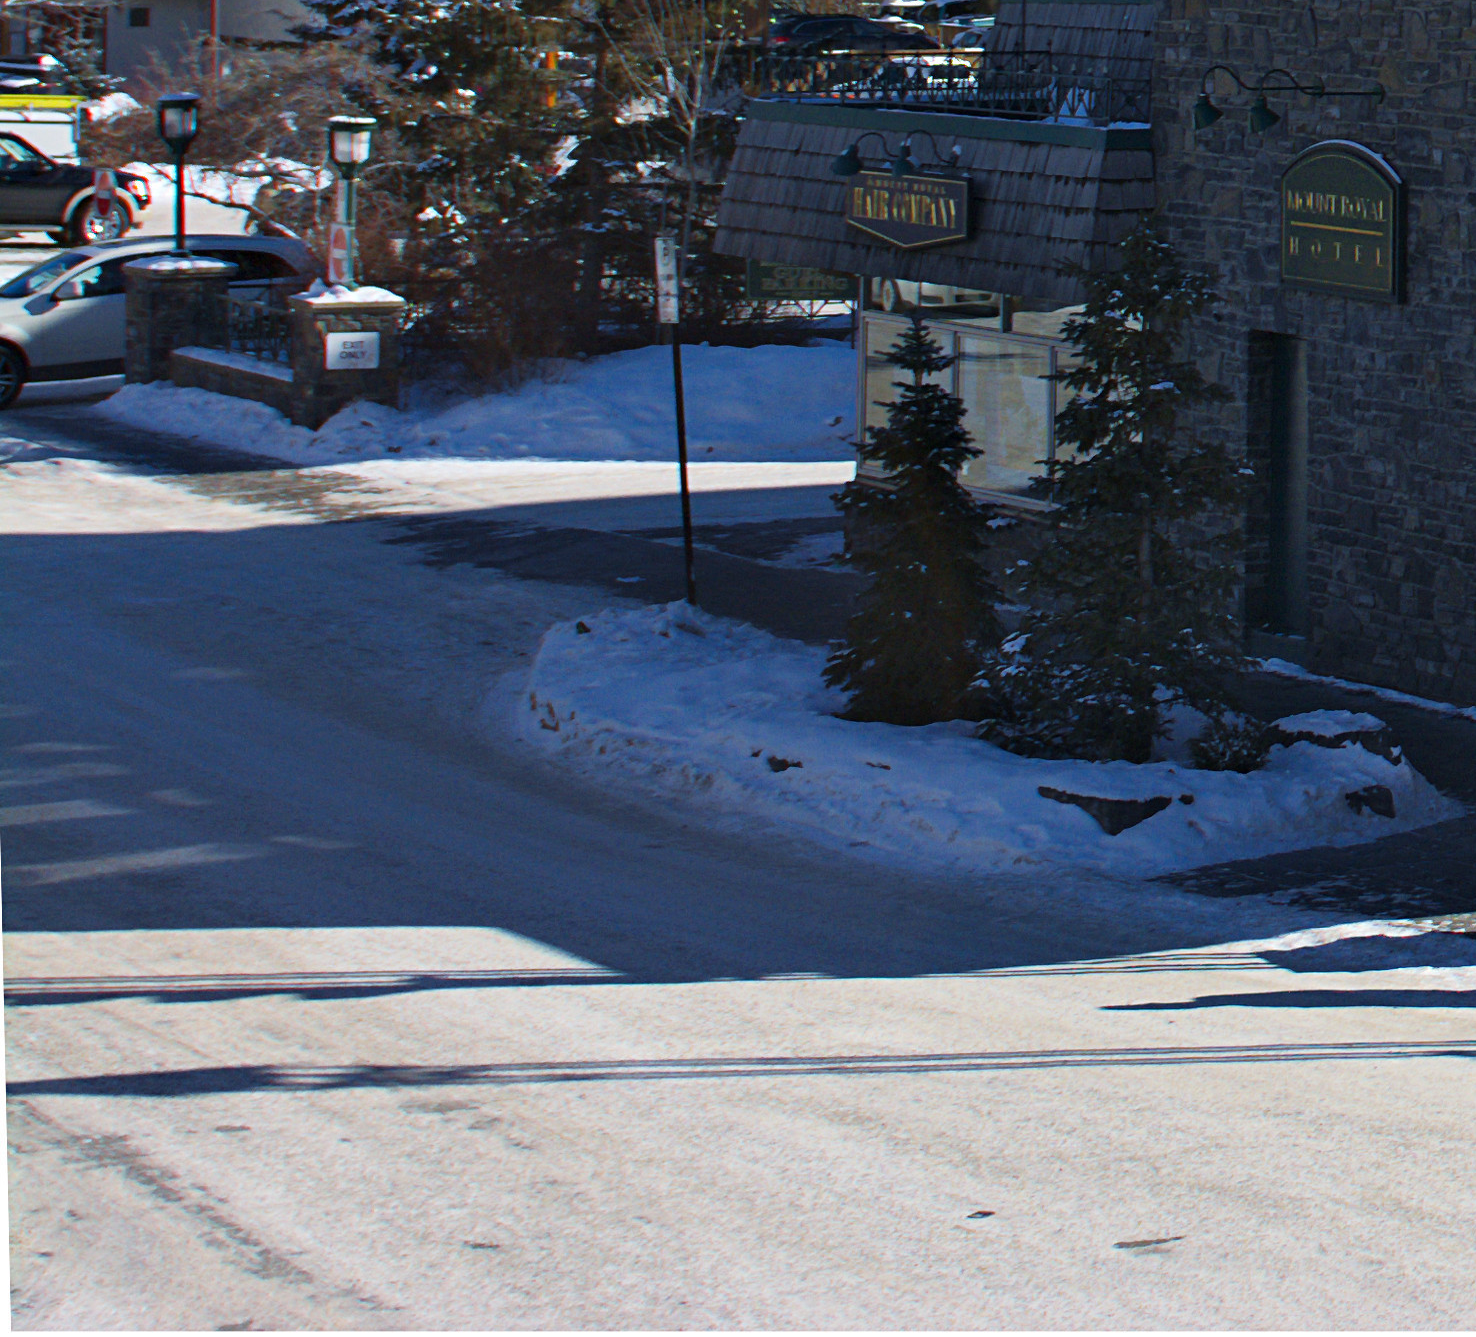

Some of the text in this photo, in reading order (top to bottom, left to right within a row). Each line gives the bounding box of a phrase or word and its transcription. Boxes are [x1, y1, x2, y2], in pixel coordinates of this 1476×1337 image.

[853, 187, 889, 220] HAIR
[1287, 190, 1387, 222] MOUNT ROYAL
[1289, 236, 1383, 267] HOTEL
